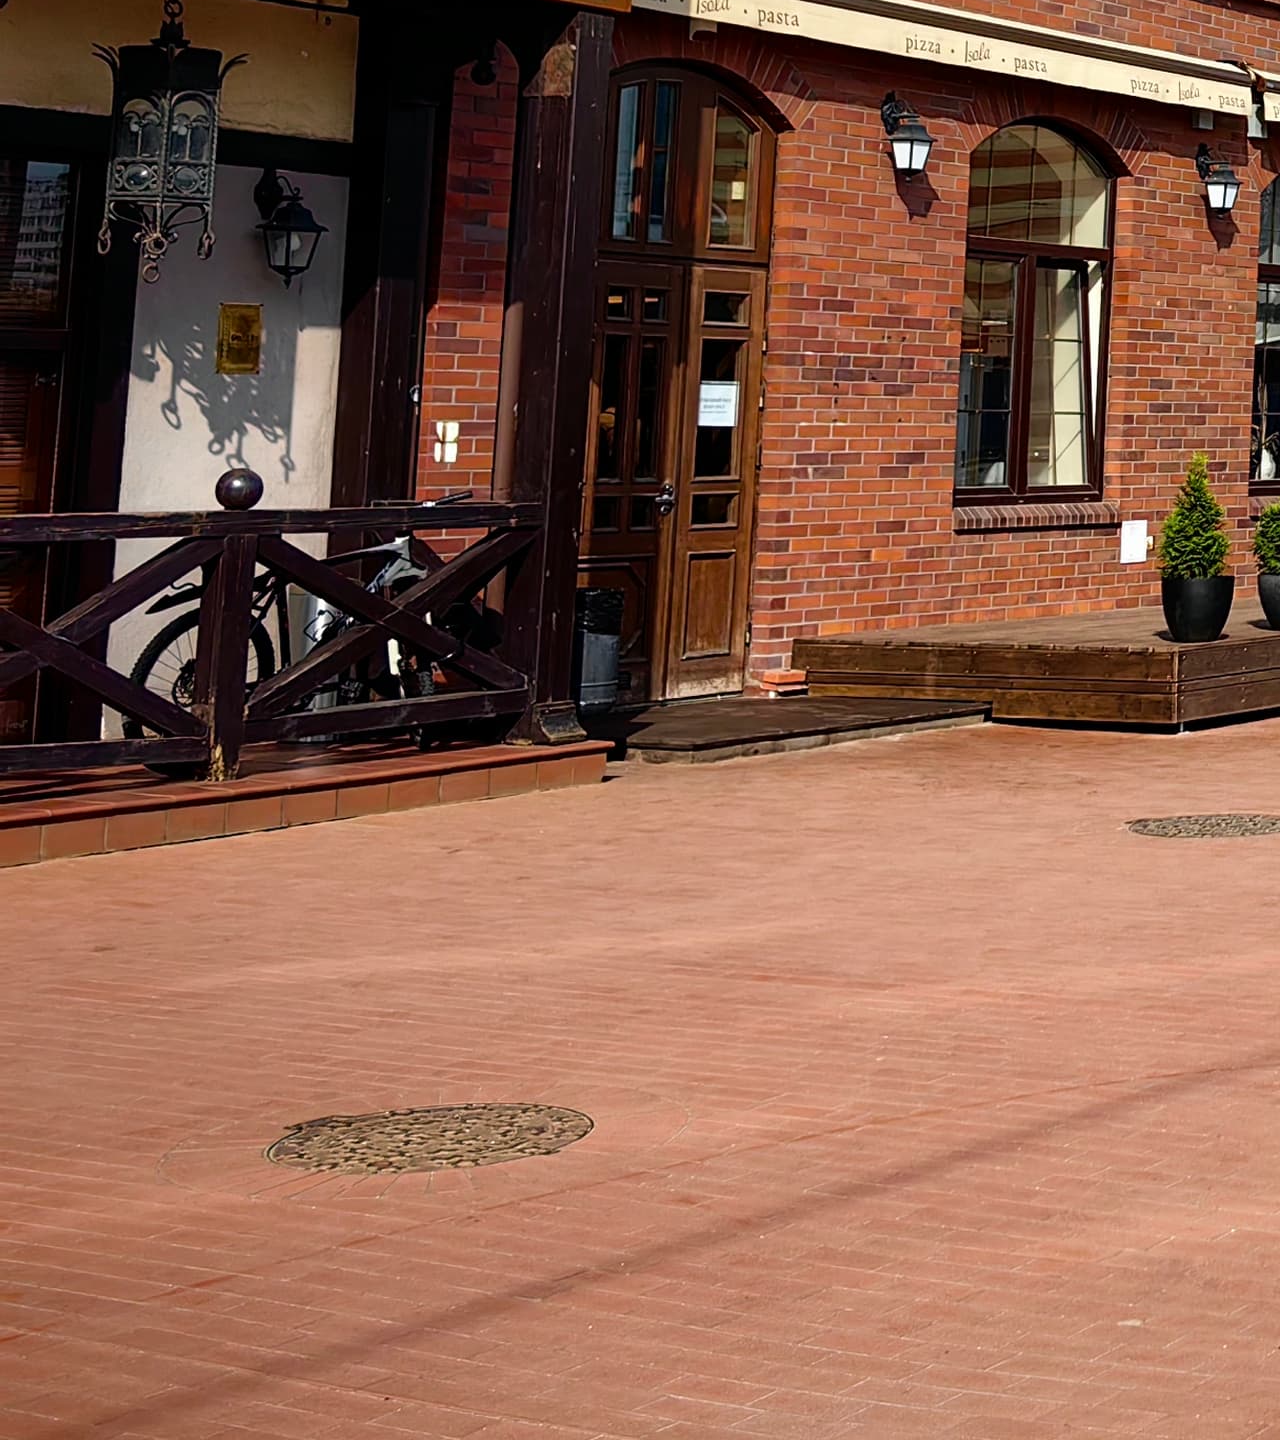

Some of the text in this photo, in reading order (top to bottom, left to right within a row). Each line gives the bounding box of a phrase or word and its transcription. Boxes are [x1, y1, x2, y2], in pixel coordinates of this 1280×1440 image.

[758, 8, 800, 27] pasta
[905, 34, 1047, 72] pizza Isola pasta
[1130, 76, 1246, 108] pizza Isola pasta
